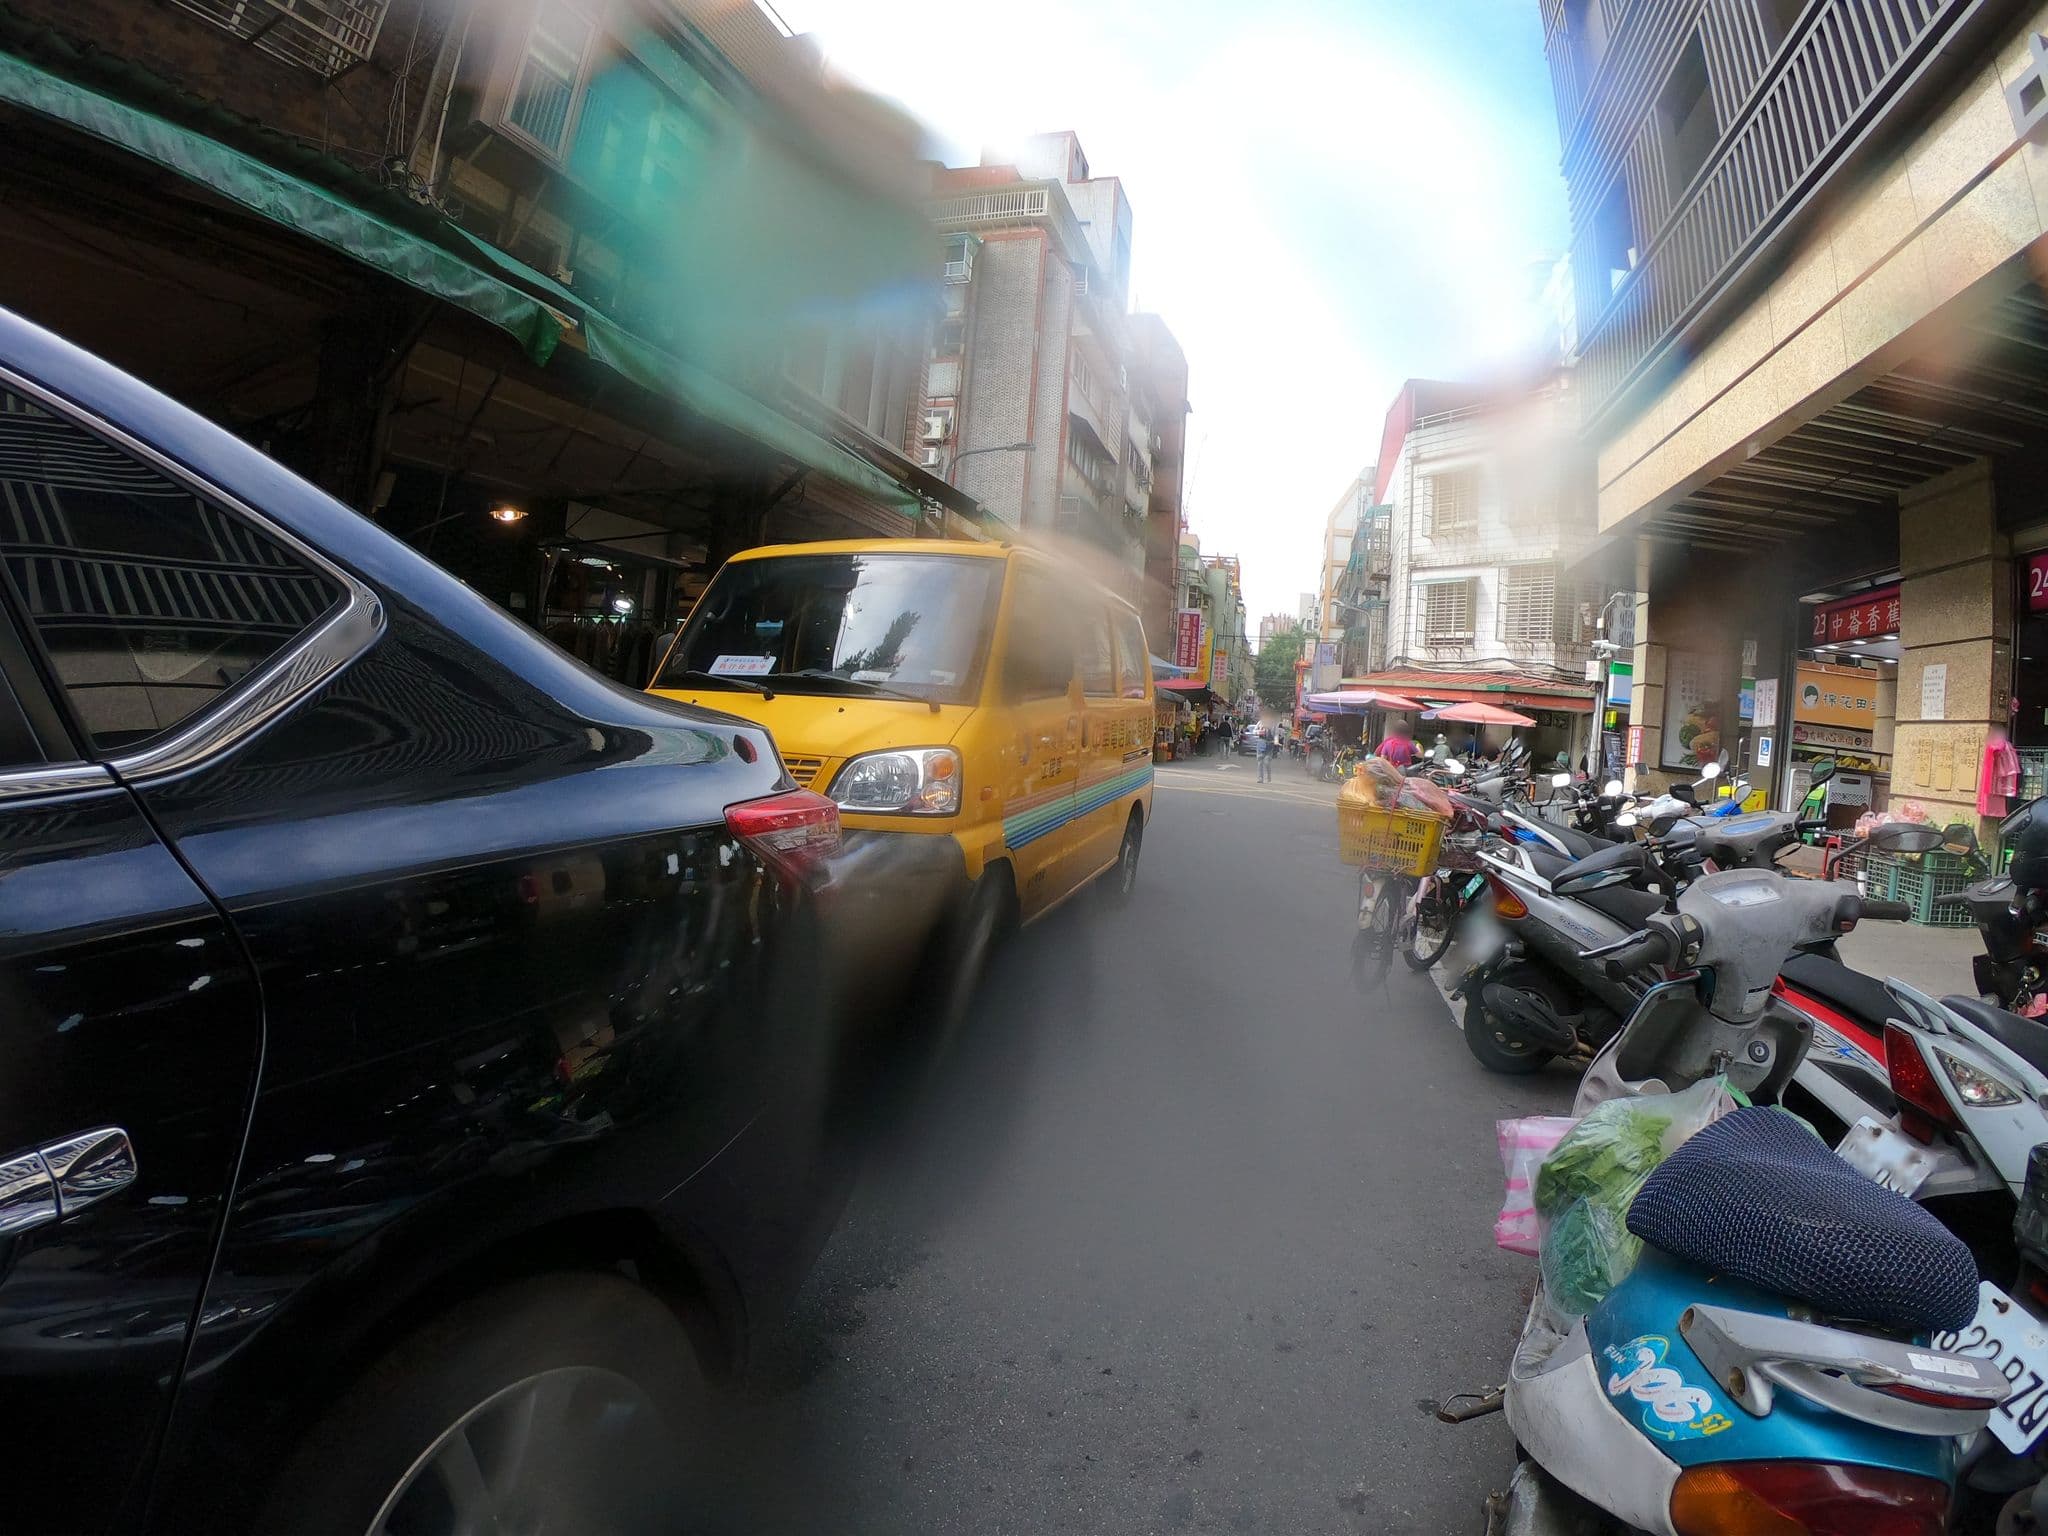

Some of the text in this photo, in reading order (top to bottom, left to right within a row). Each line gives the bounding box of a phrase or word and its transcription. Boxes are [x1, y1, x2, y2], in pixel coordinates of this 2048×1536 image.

[1813, 600, 1900, 638] 23 中崙香蕉
[1604, 1344, 1627, 1364] FUN
